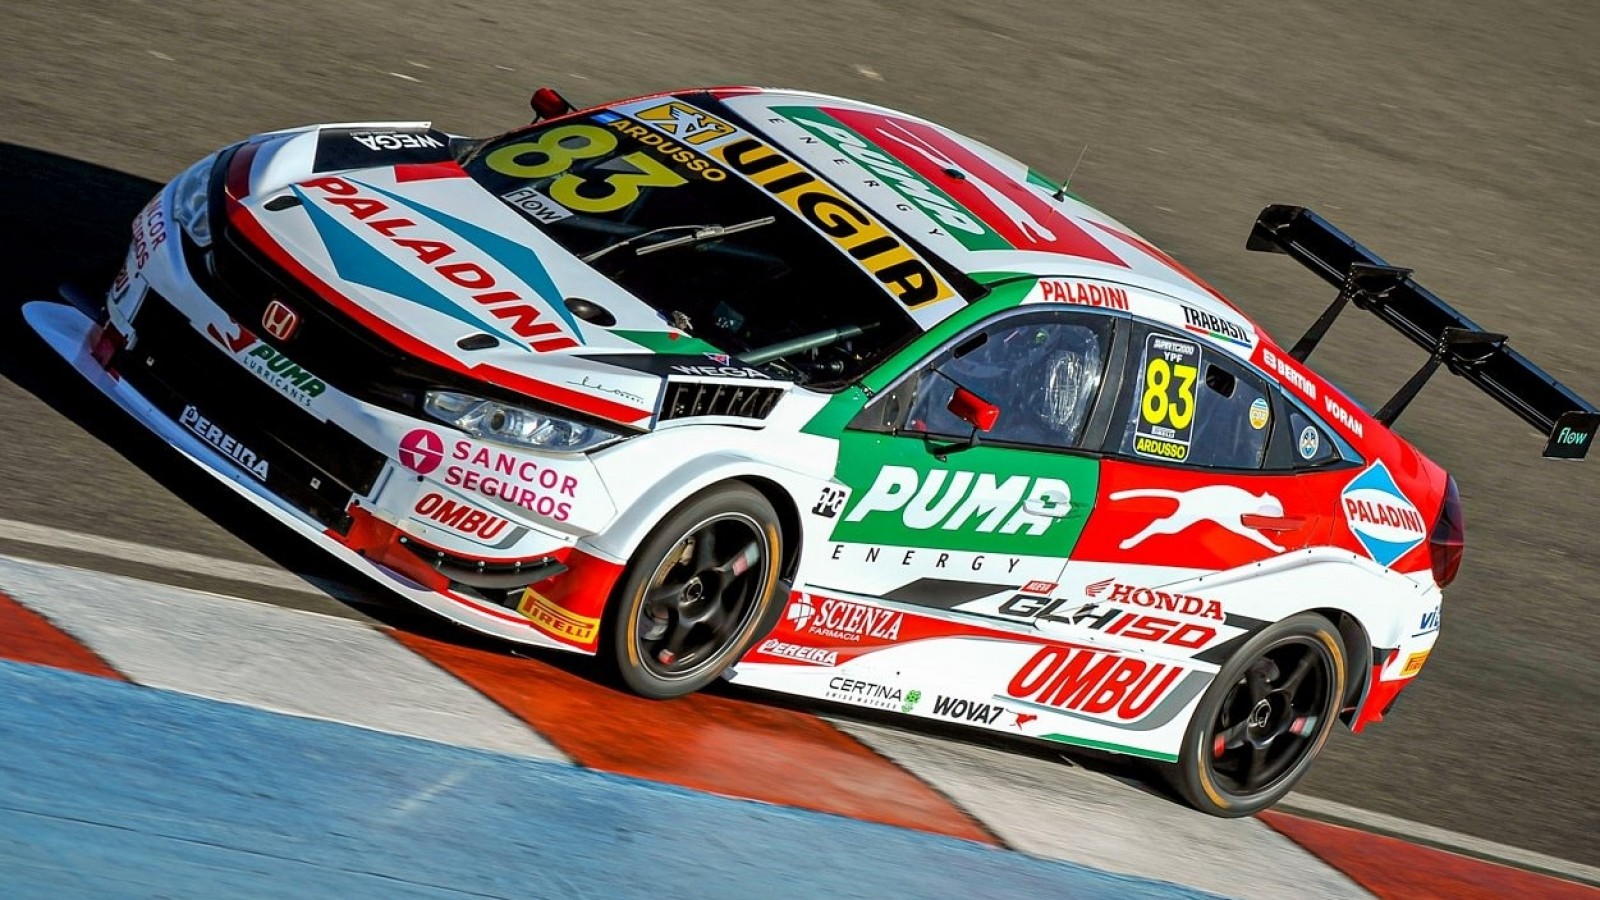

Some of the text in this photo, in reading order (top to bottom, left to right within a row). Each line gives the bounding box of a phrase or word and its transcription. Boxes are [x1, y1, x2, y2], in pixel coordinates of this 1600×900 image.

[352, 134, 445, 151] WEGA
[608, 120, 728, 182] ARDUSSO
[486, 124, 689, 213] 83
[767, 117, 944, 236] ENERGY
[792, 117, 985, 235] PUMA
[505, 189, 564, 222] flow
[300, 177, 582, 353] PALADINI
[1039, 281, 1130, 310] PALADINI
[1180, 304, 1252, 343] TRABASIL
[249, 343, 326, 398] PUMA
[671, 365, 771, 379] WEGA
[1163, 351, 1183, 363] YPF
[243, 356, 312, 407] LUBRICANTS
[1142, 358, 1197, 429] 83
[1324, 395, 1364, 438] VORAN
[1557, 427, 1588, 444] flow
[178, 405, 269, 481] PEREIRA
[1136, 437, 1186, 458] ARDUSSO
[452, 441, 579, 498] SANCOR
[444, 466, 573, 522] SEGUROS
[844, 465, 1072, 536] PUMA
[414, 492, 509, 540] OMBU
[1344, 497, 1424, 534] PALADINI
[831, 544, 1020, 573] ENERGY
[521, 597, 595, 639] PIRELLI
[812, 599, 904, 641] SCIENZA
[1107, 583, 1225, 622] HONDA
[757, 638, 839, 667] PEREIRA
[808, 626, 861, 642] FARMACIA
[829, 676, 902, 702] CERTINA
[1007, 644, 1184, 720] OMBU
[932, 695, 1004, 726] WOVA7
